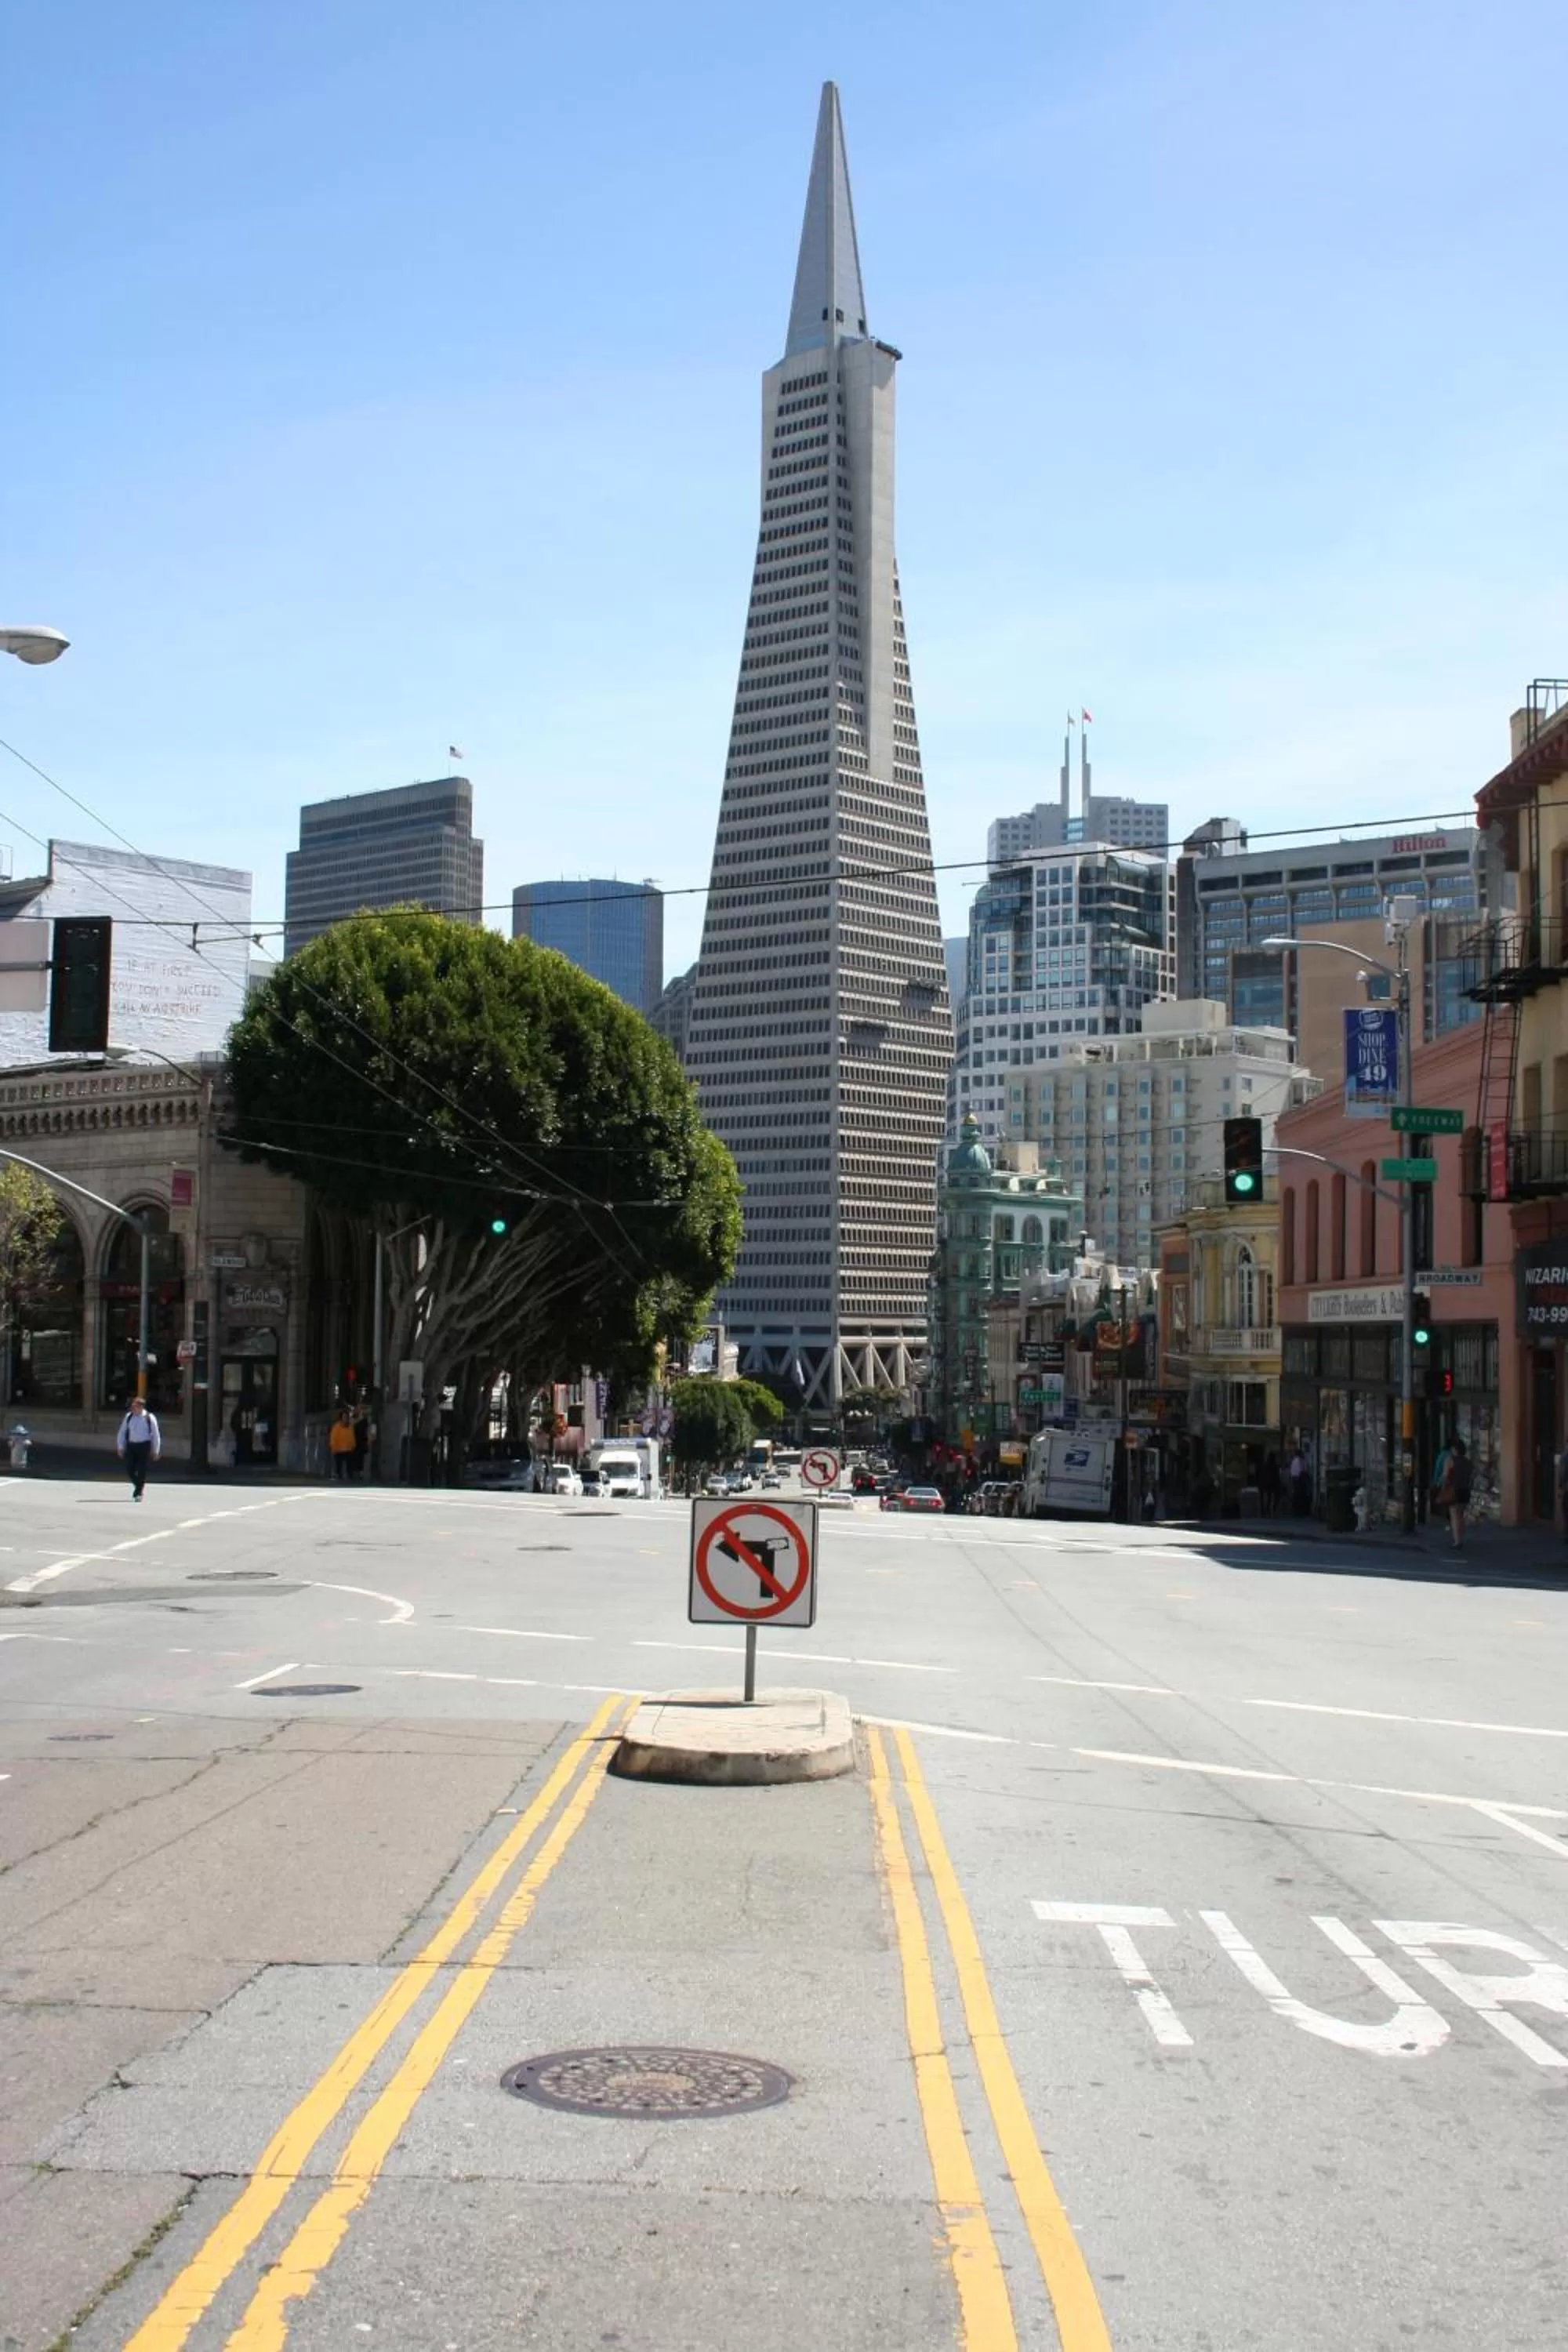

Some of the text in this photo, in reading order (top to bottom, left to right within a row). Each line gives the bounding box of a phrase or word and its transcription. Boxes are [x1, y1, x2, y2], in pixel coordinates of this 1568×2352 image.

[1392, 837, 1446, 853] Hilton
[1358, 1033, 1386, 1047] SHOP
[1358, 1047, 1387, 1064] DINE
[1357, 1065, 1387, 1081] 49
[1419, 1273, 1479, 1283] BROADWAY
[1031, 1900, 1568, 2067] TUR
